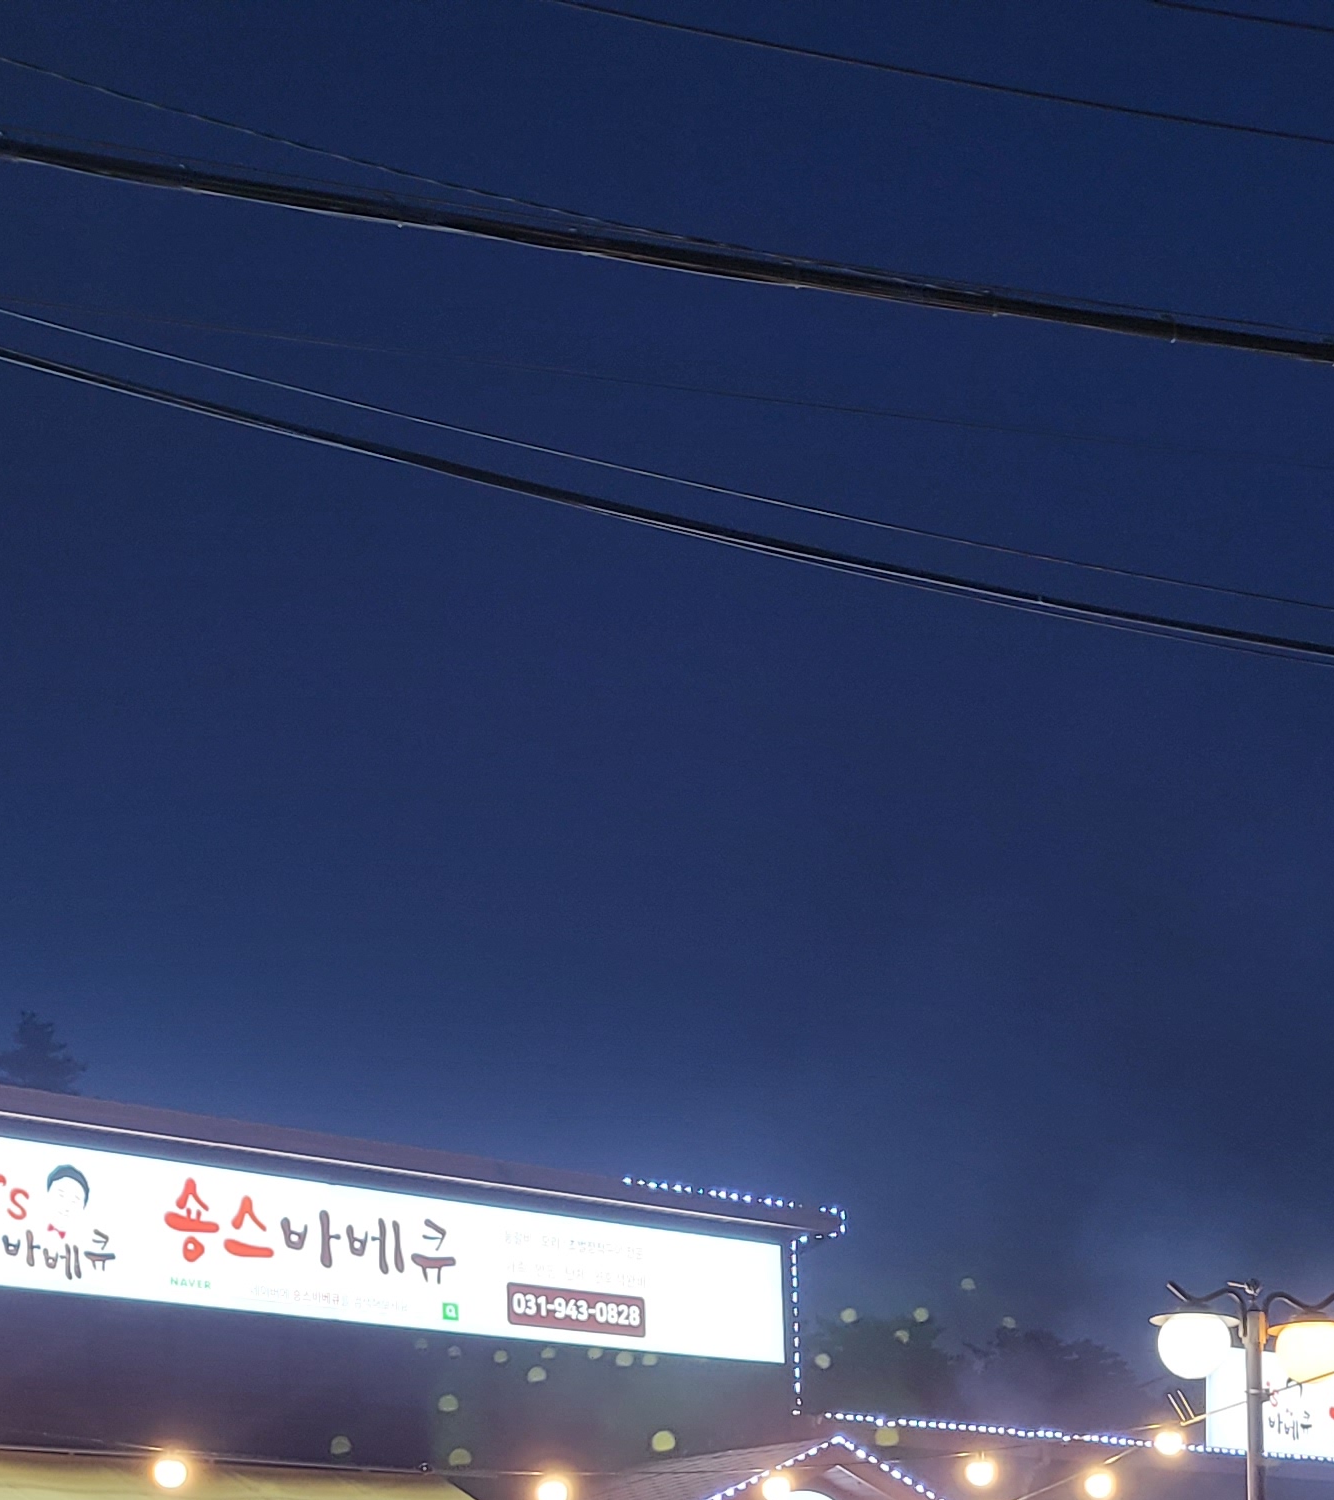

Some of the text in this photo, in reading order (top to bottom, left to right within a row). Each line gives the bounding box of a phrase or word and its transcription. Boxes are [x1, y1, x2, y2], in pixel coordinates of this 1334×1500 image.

[164, 1177, 456, 1284] 송스바베큐
[2, 1229, 116, 1280] 바베큐
[170, 1276, 212, 1290] NAVER
[512, 1292, 641, 1327] 031-943-0828
